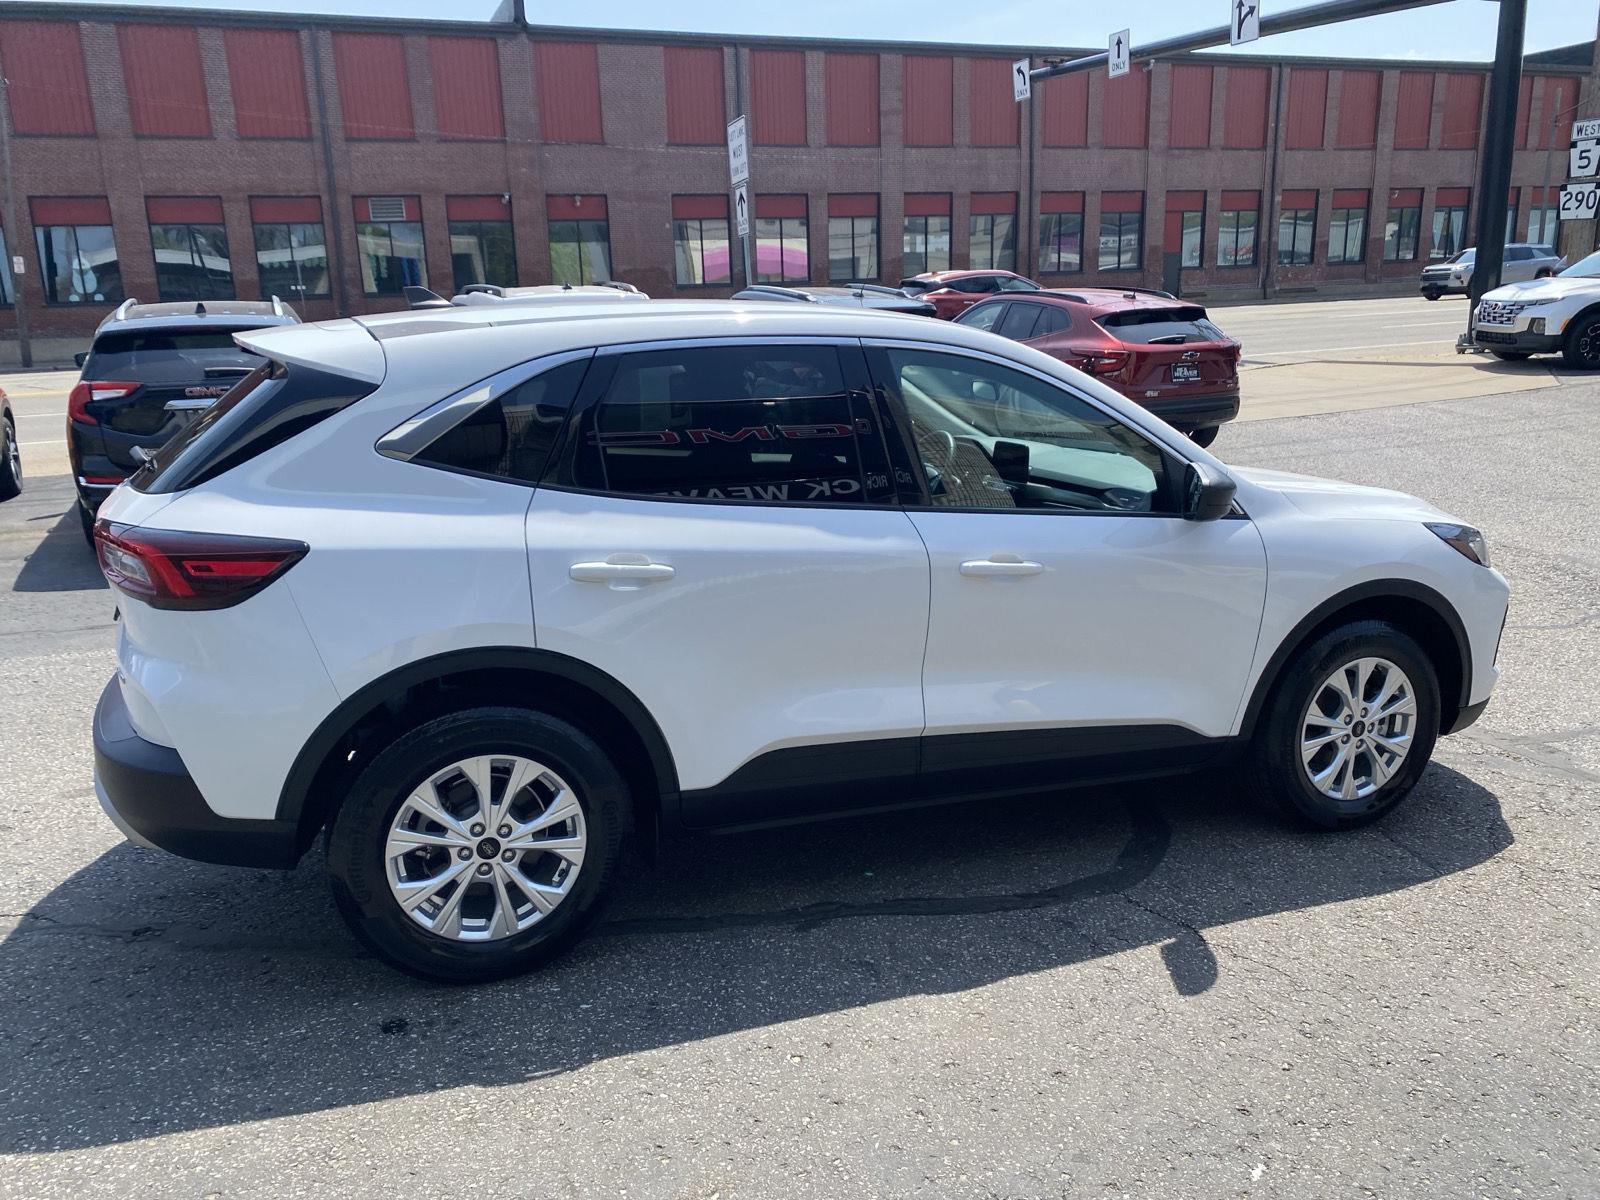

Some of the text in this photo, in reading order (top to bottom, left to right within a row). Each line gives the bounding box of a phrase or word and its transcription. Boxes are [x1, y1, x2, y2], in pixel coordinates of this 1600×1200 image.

[1111, 61, 1126, 72] ONLY
[1016, 88, 1028, 98] ONLY
[1576, 124, 1600, 136] WEST
[1577, 149, 1592, 169] 5
[1561, 190, 1598, 211] 290
[185, 386, 230, 396] GMC
